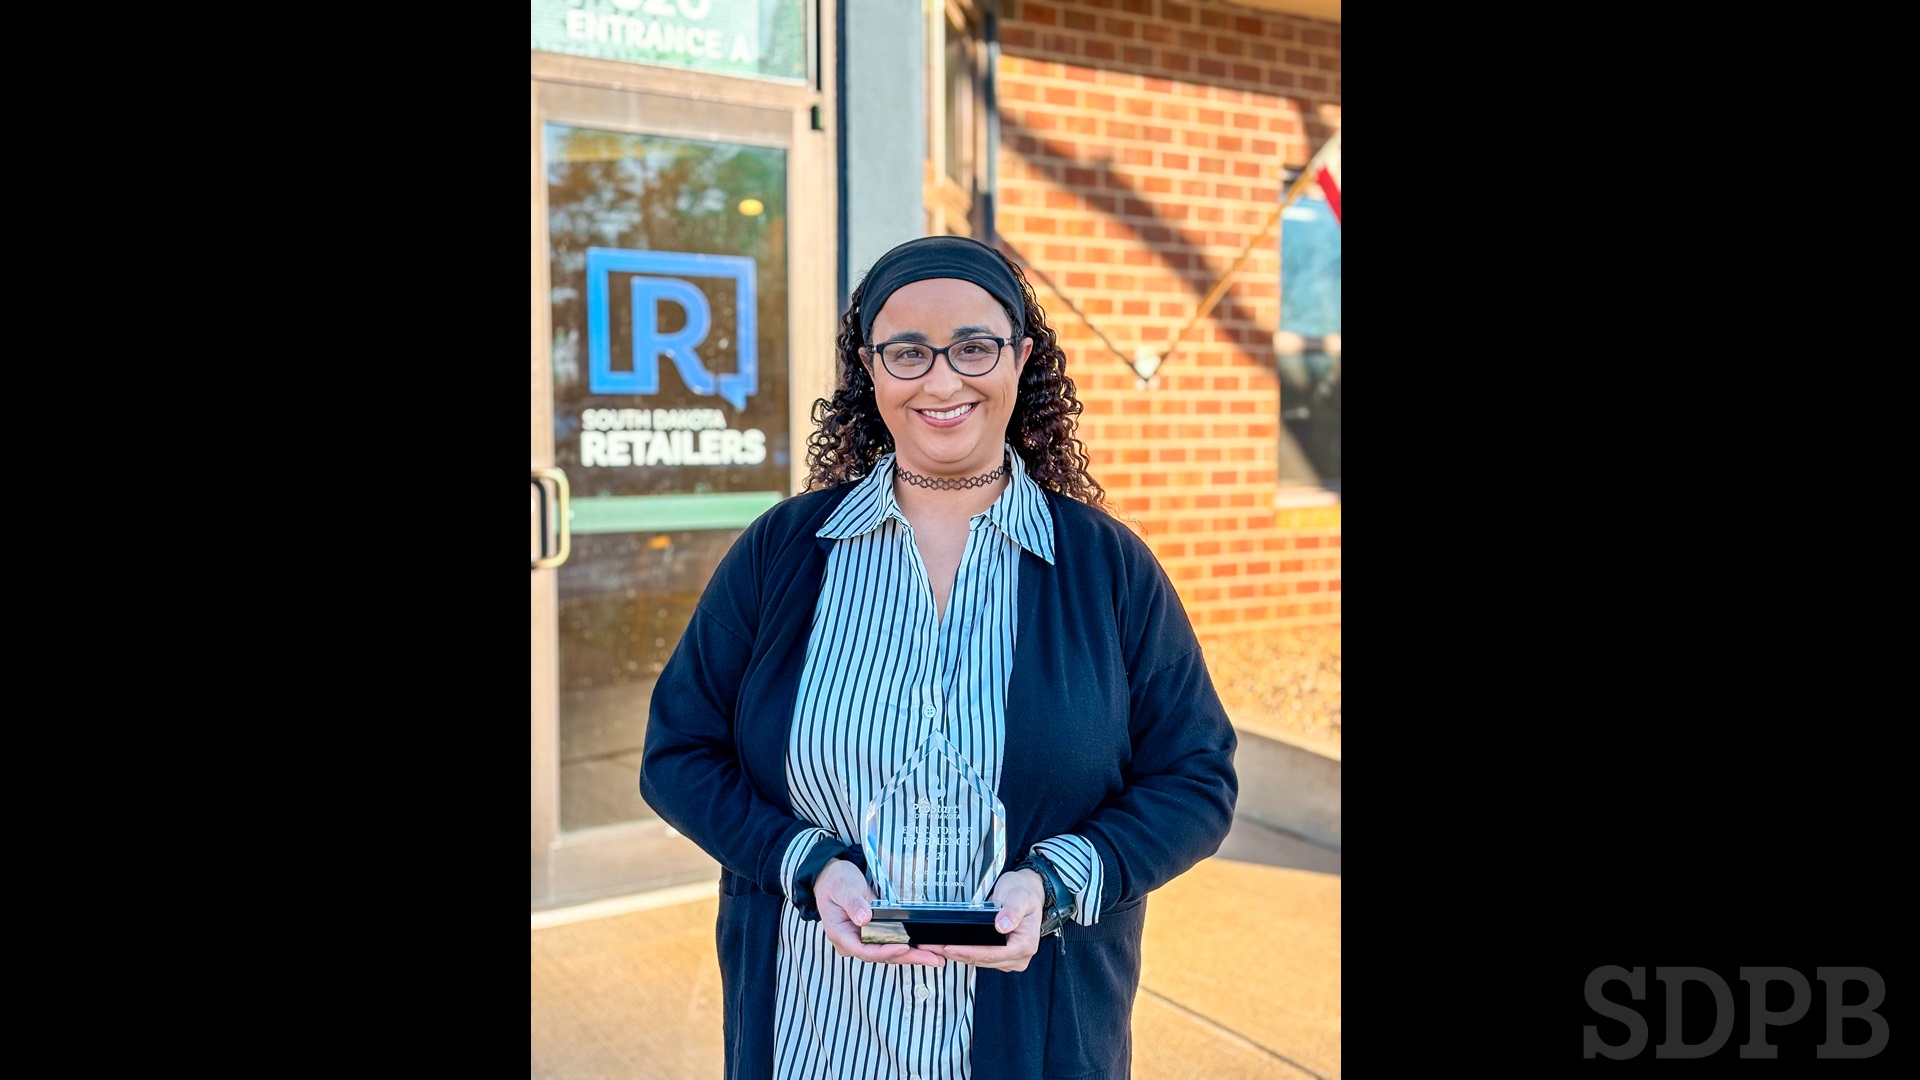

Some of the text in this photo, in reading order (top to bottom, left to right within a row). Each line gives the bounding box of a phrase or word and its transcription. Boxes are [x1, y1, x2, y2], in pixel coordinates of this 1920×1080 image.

[566, 8, 723, 59] ENTRANCE
[729, 32, 751, 64] A
[581, 408, 727, 431] SOUTH DAKOTA
[580, 428, 767, 467] RETAILERS
[902, 826, 956, 835] EUCTOR
[902, 837, 971, 846] EXELLENCE
